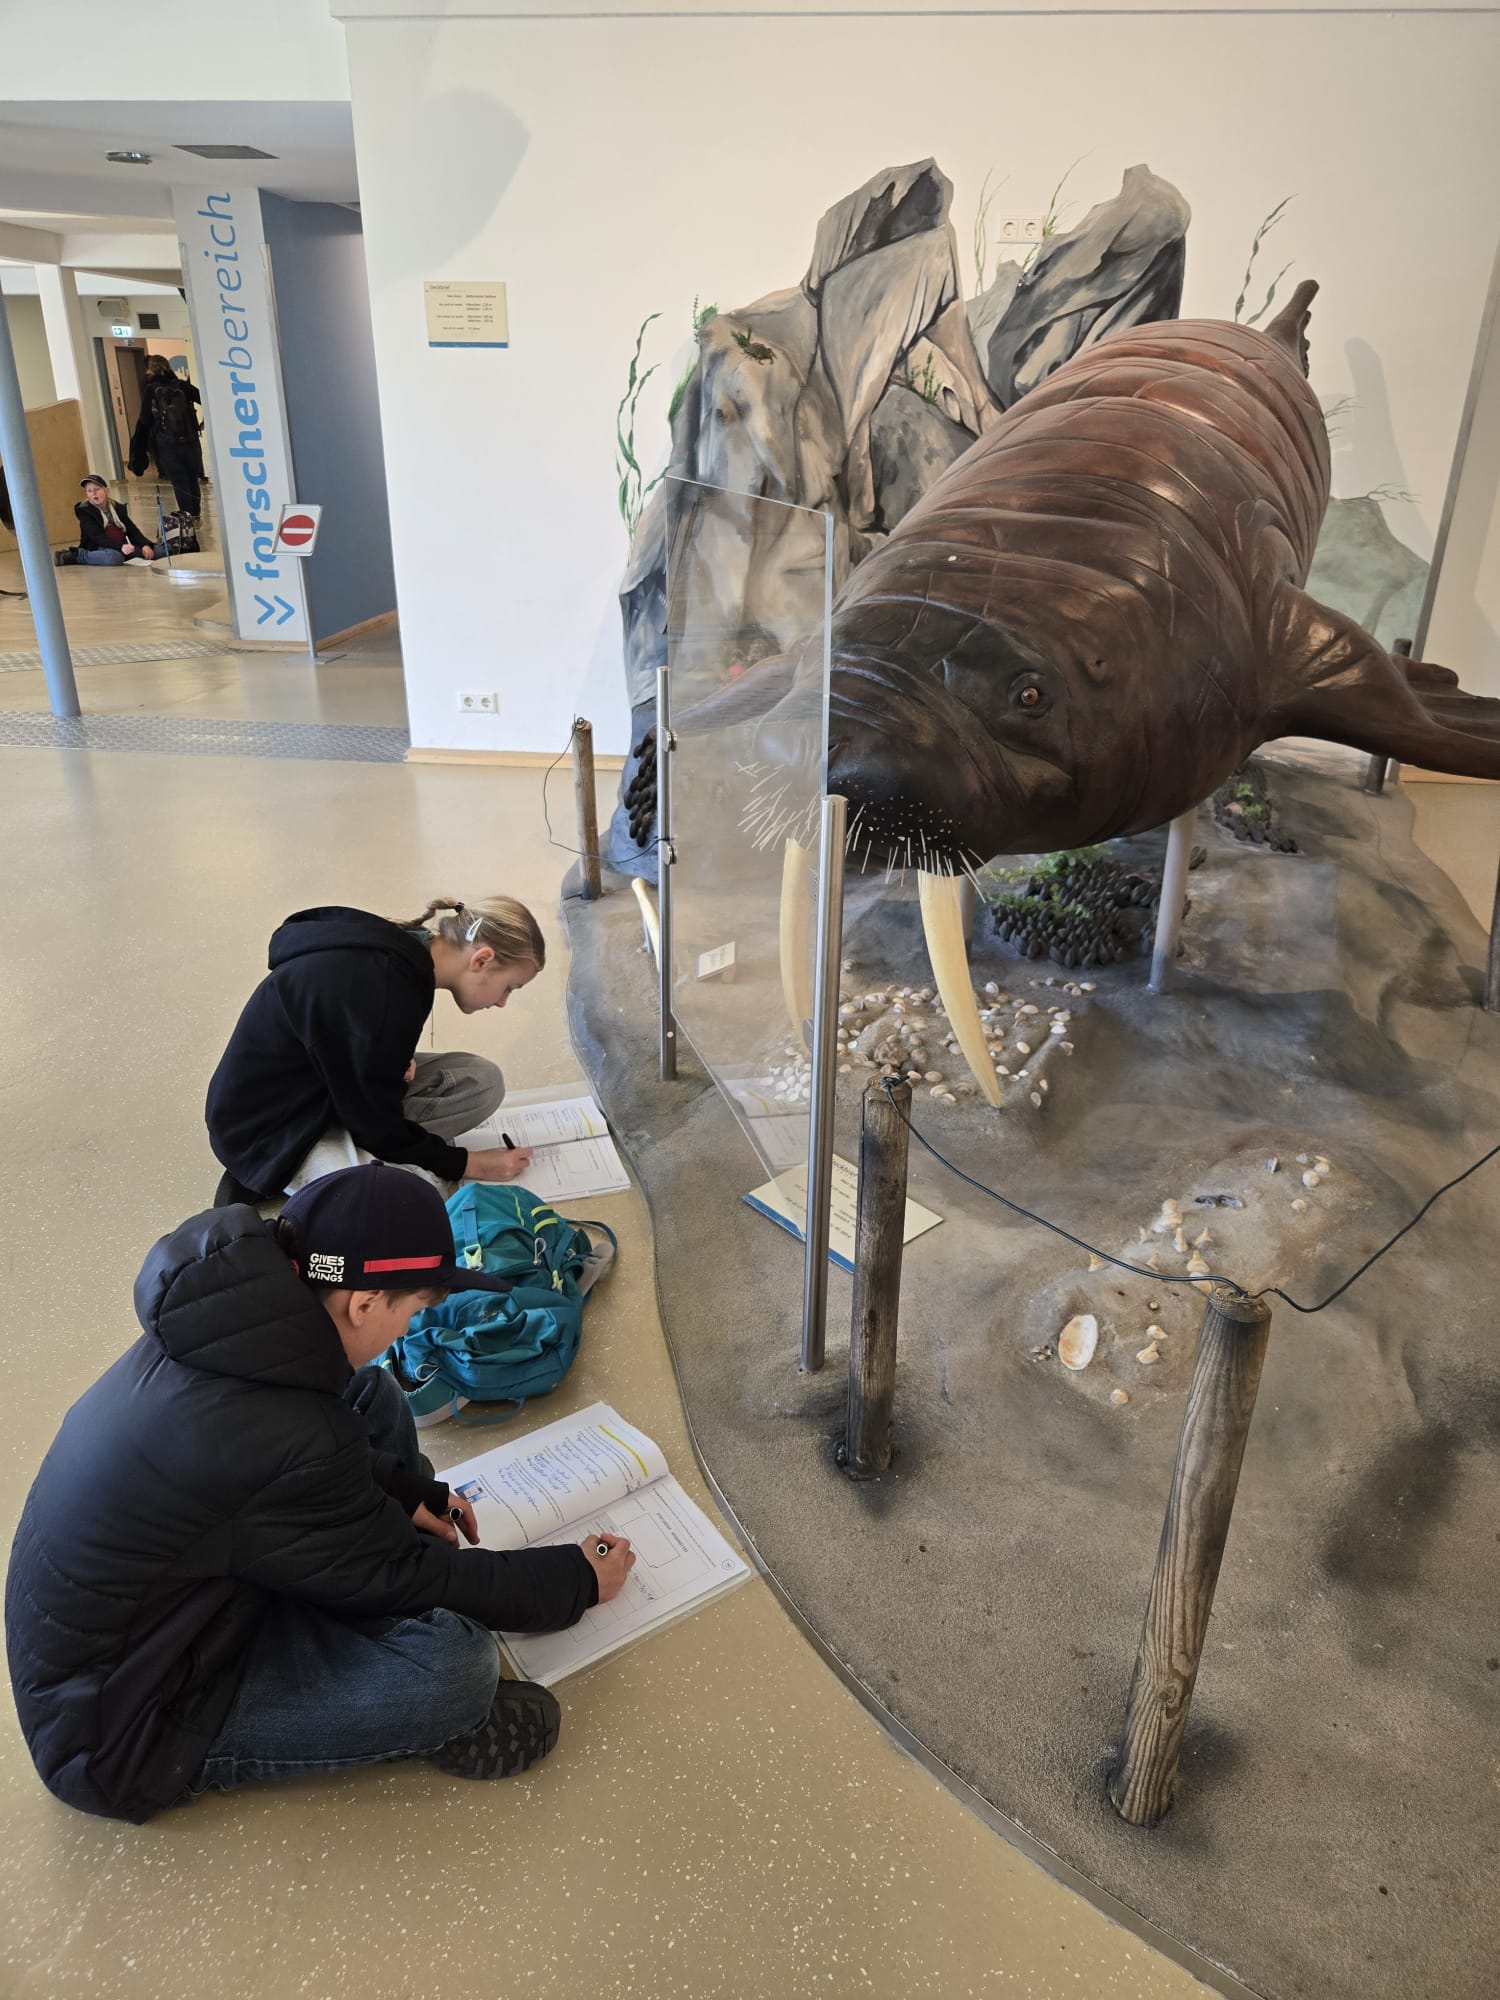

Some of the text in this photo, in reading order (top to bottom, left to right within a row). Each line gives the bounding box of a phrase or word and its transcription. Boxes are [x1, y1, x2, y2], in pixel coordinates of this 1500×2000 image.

[197, 192, 280, 581] forscherbereich
[310, 1253, 344, 1266] GIVES
[309, 1263, 343, 1274] YOU
[307, 1271, 342, 1282] WINGS
